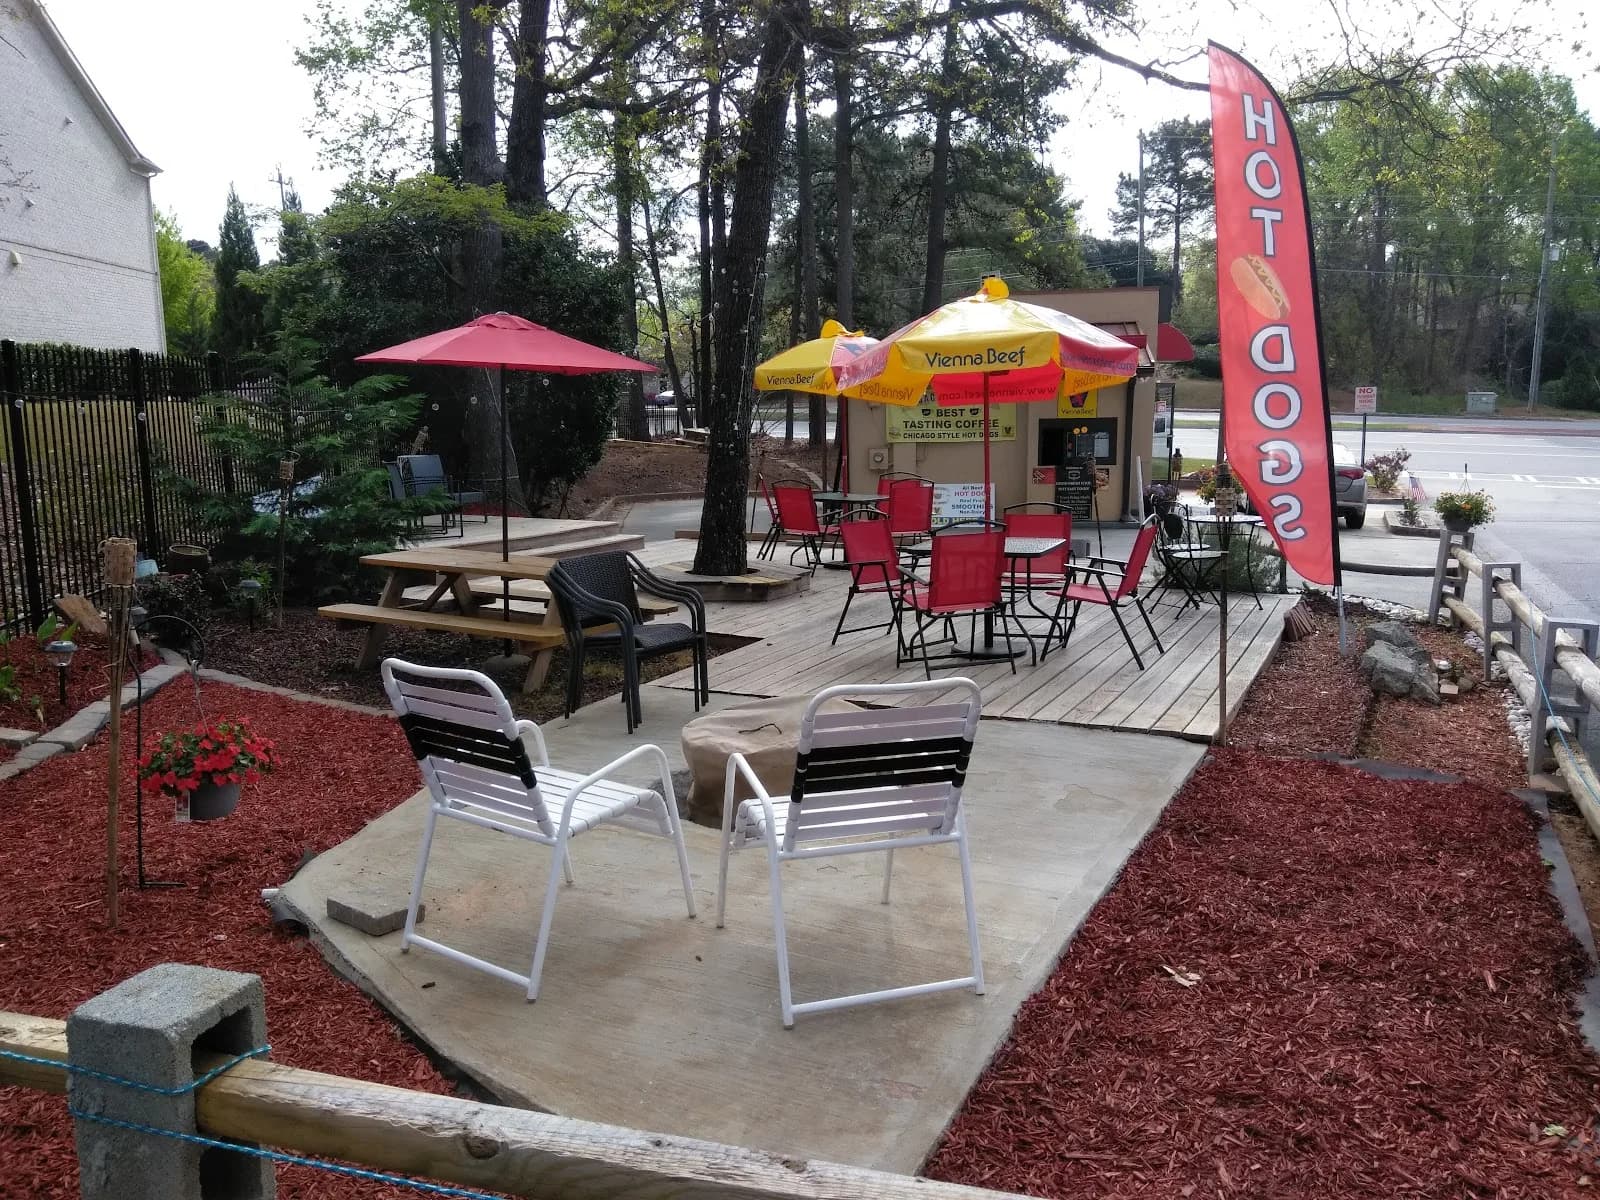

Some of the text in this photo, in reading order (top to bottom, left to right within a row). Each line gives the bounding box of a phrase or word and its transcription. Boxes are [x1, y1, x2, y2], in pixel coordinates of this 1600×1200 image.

[925, 346, 1025, 368] Vienna Beef
[796, 372, 815, 385] Beef
[936, 408, 966, 417] BEST
[902, 420, 952, 429] TASTING
